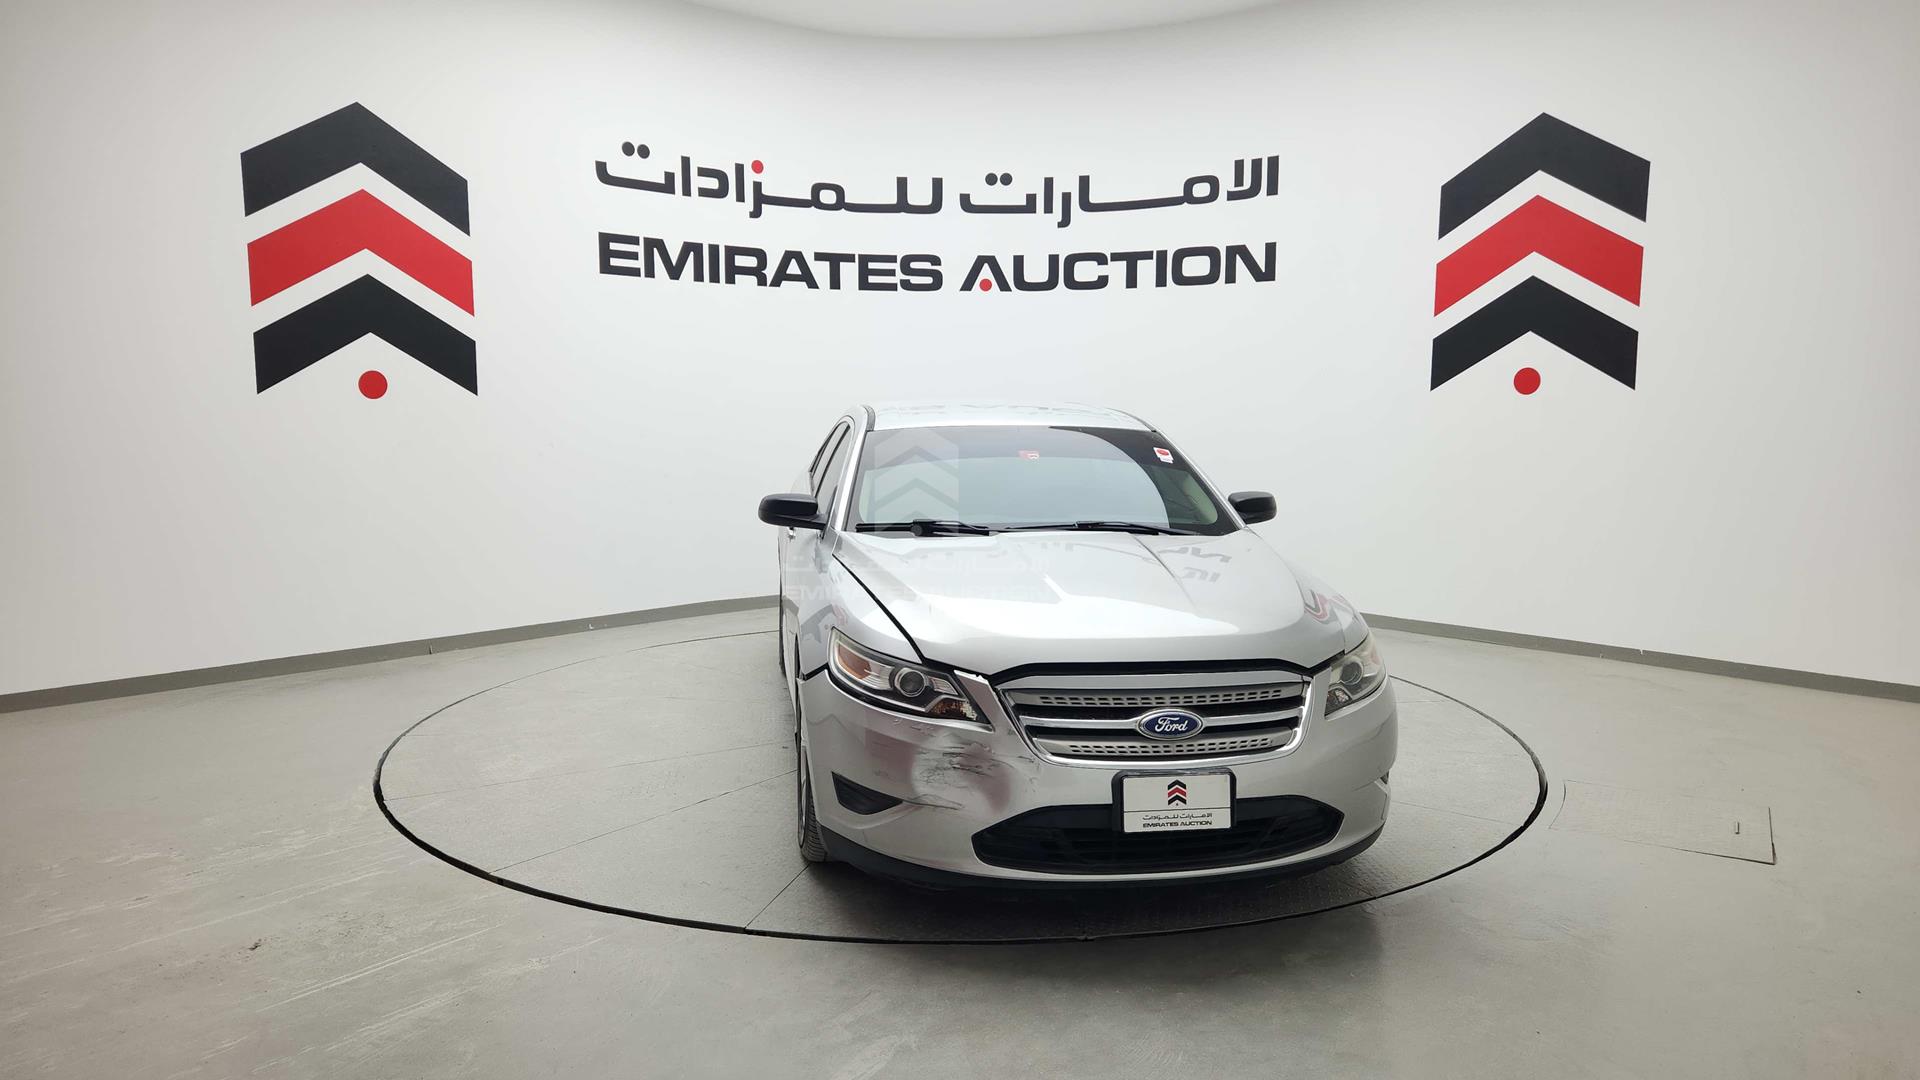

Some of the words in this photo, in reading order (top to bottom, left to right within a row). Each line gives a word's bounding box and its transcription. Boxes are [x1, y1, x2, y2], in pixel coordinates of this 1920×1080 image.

[598, 231, 944, 292] EMIRATES
[959, 241, 1277, 293] AUCTION
[1155, 716, 1189, 732] Ford
[1142, 821, 1179, 829] EMIRATES
